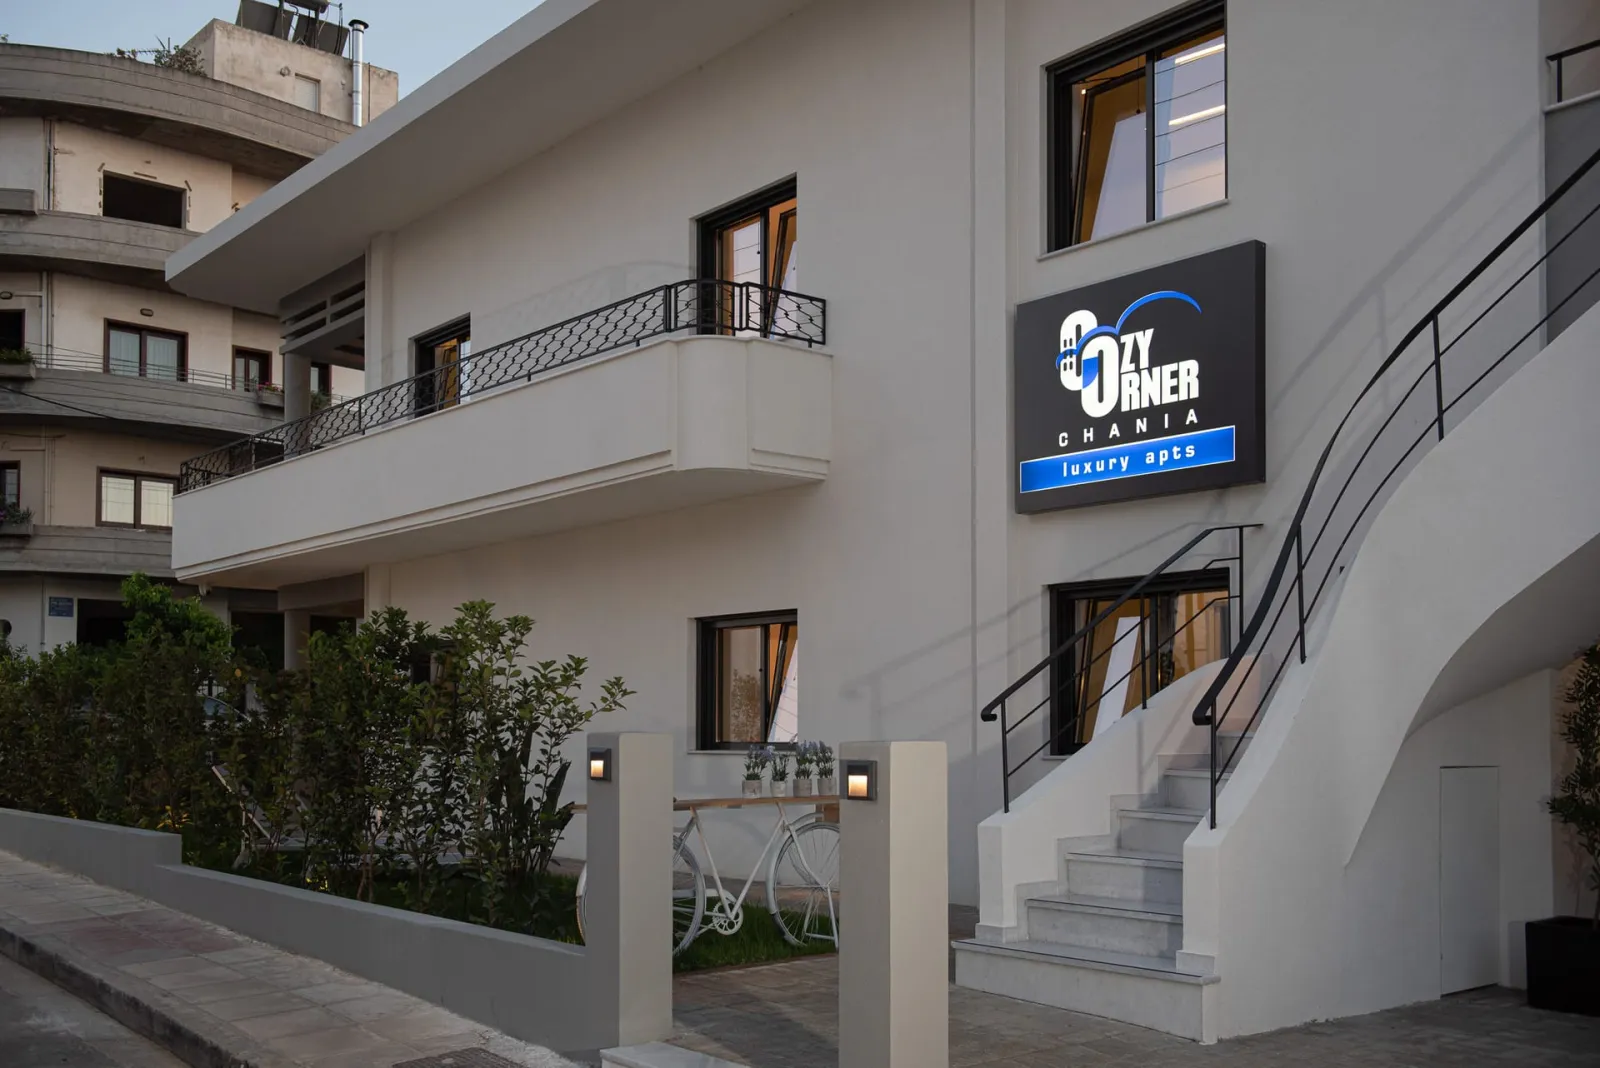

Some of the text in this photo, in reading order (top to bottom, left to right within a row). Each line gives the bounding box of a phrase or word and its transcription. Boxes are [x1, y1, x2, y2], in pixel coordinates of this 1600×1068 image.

[1058, 408, 1198, 447] CHANIA
[1062, 444, 1196, 477] luxury apts
